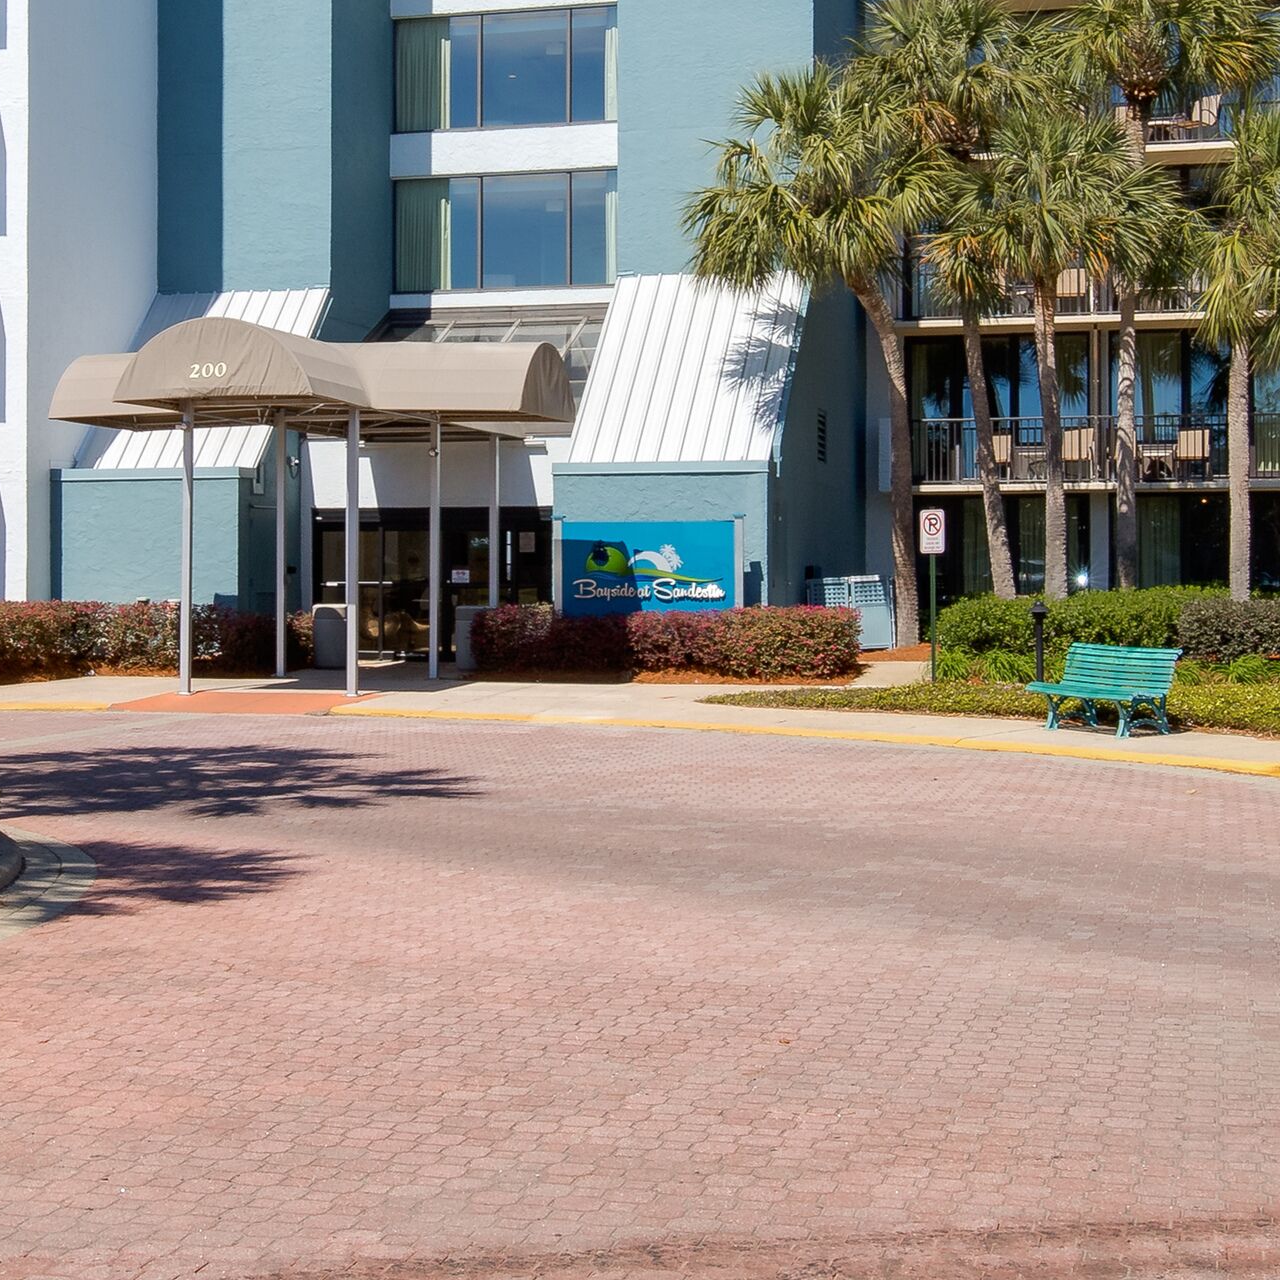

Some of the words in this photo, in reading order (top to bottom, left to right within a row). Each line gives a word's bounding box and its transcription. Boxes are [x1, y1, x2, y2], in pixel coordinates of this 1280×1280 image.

[189, 362, 227, 379] 200
[572, 578, 636, 601] Bayside
[637, 585, 652, 599] at
[653, 578, 726, 600] Sandestin
